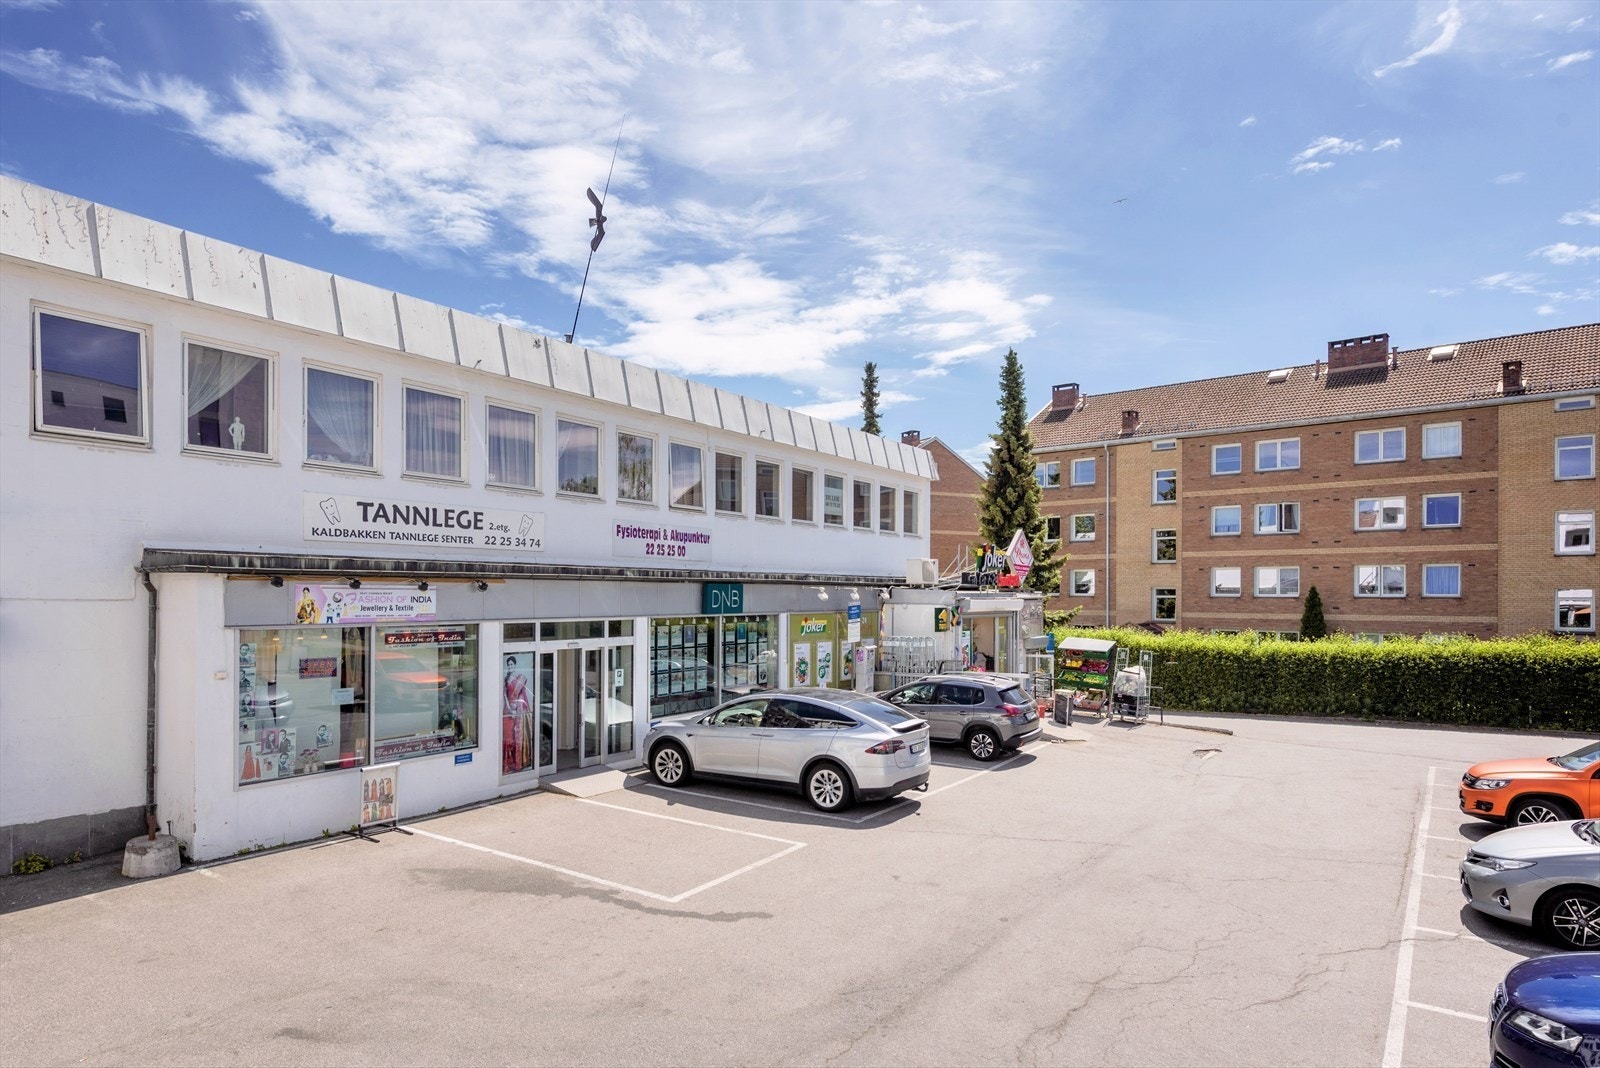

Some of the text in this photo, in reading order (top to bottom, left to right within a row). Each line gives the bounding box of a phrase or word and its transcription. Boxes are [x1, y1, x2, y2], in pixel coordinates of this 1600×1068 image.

[357, 501, 510, 533] TANNLEGE 2.etg.
[311, 527, 541, 548] KALDBAKKEN TANNLEGE SENTER 22 25 34 74
[616, 525, 711, 544] Fysioterapi & Akupunktur
[645, 543, 686, 557] 22 25 25 00
[981, 544, 1007, 572] joker
[396, 595, 408, 604] OF
[410, 596, 432, 604] INDIA
[711, 585, 740, 612] DNB
[801, 617, 825, 636] joker
[387, 635, 424, 644] Fashion
[438, 634, 462, 642] India
